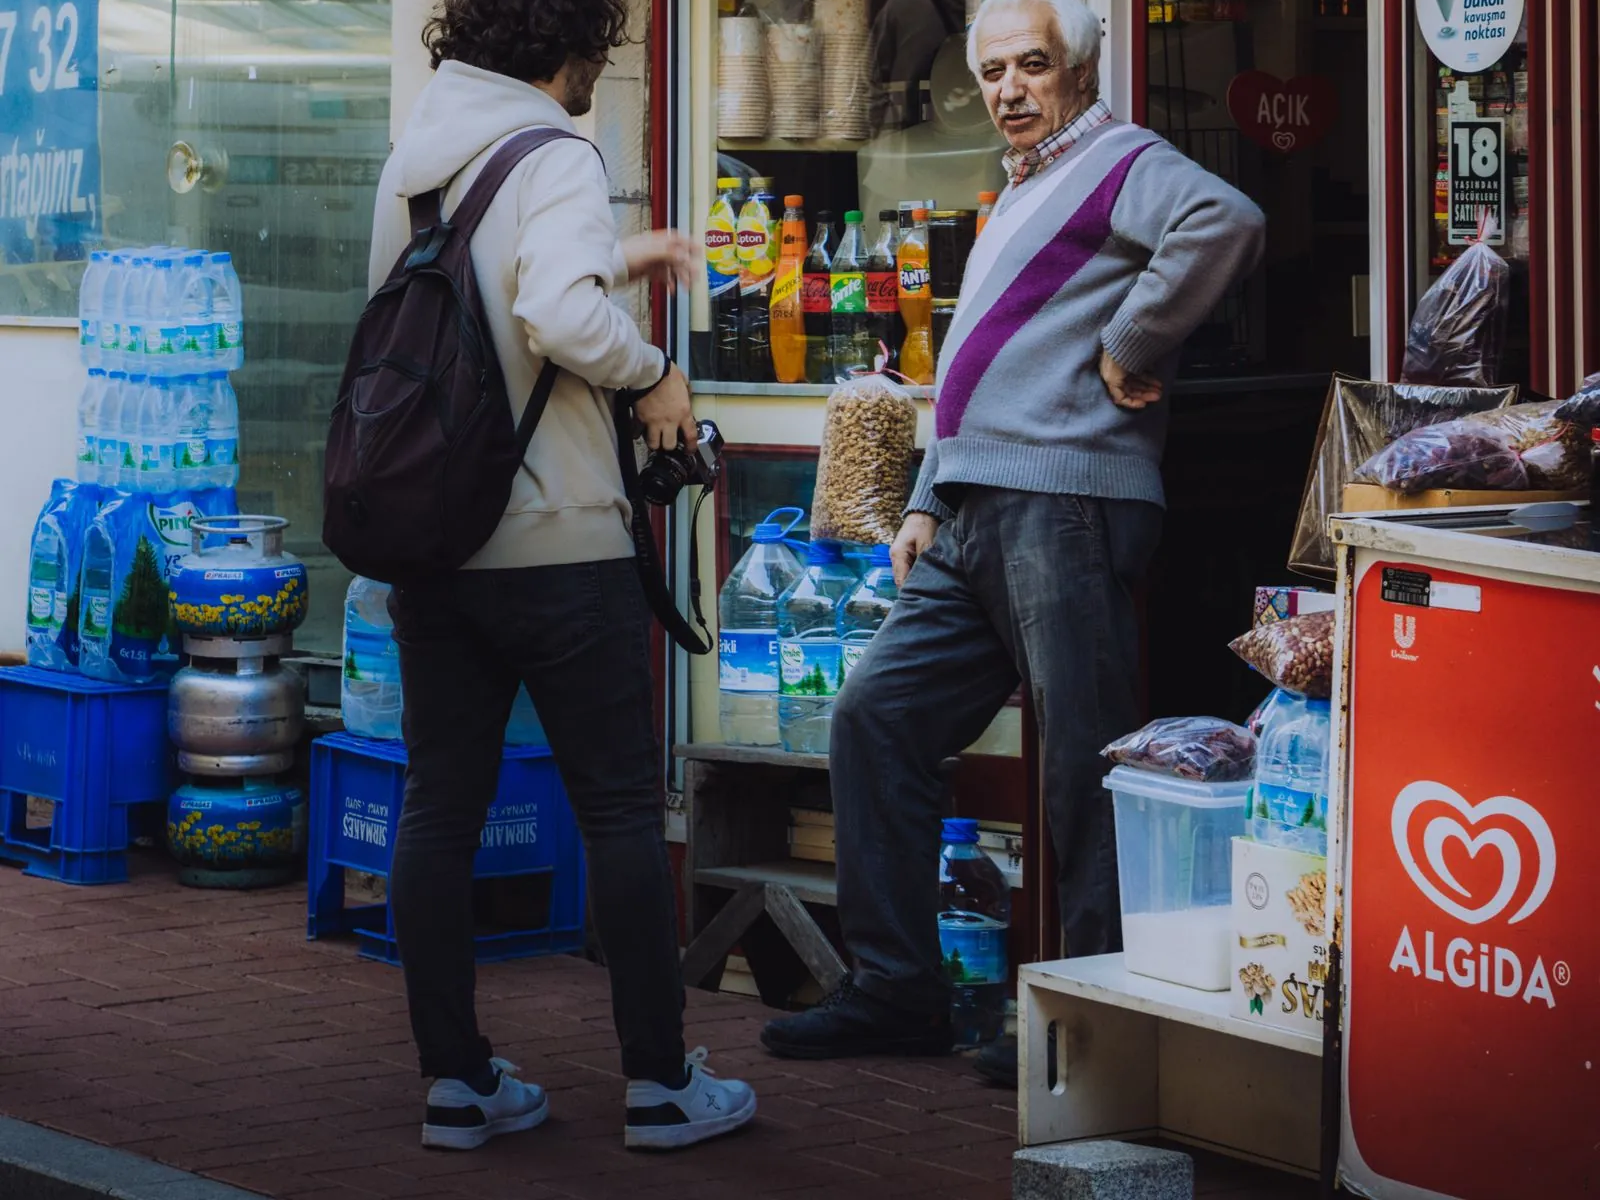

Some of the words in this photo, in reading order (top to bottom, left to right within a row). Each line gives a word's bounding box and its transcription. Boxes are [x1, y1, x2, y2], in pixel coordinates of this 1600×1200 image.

[1464, 9, 1506, 26] kavuşma
[1464, 25, 1506, 41] noktası
[30, 2, 79, 93] 32
[1257, 92, 1310, 128] AÇIK
[1454, 127, 1499, 178] 18
[1455, 181, 1498, 191] YAŞINDAN
[1455, 191, 1499, 203] KÜÇÜKLERE
